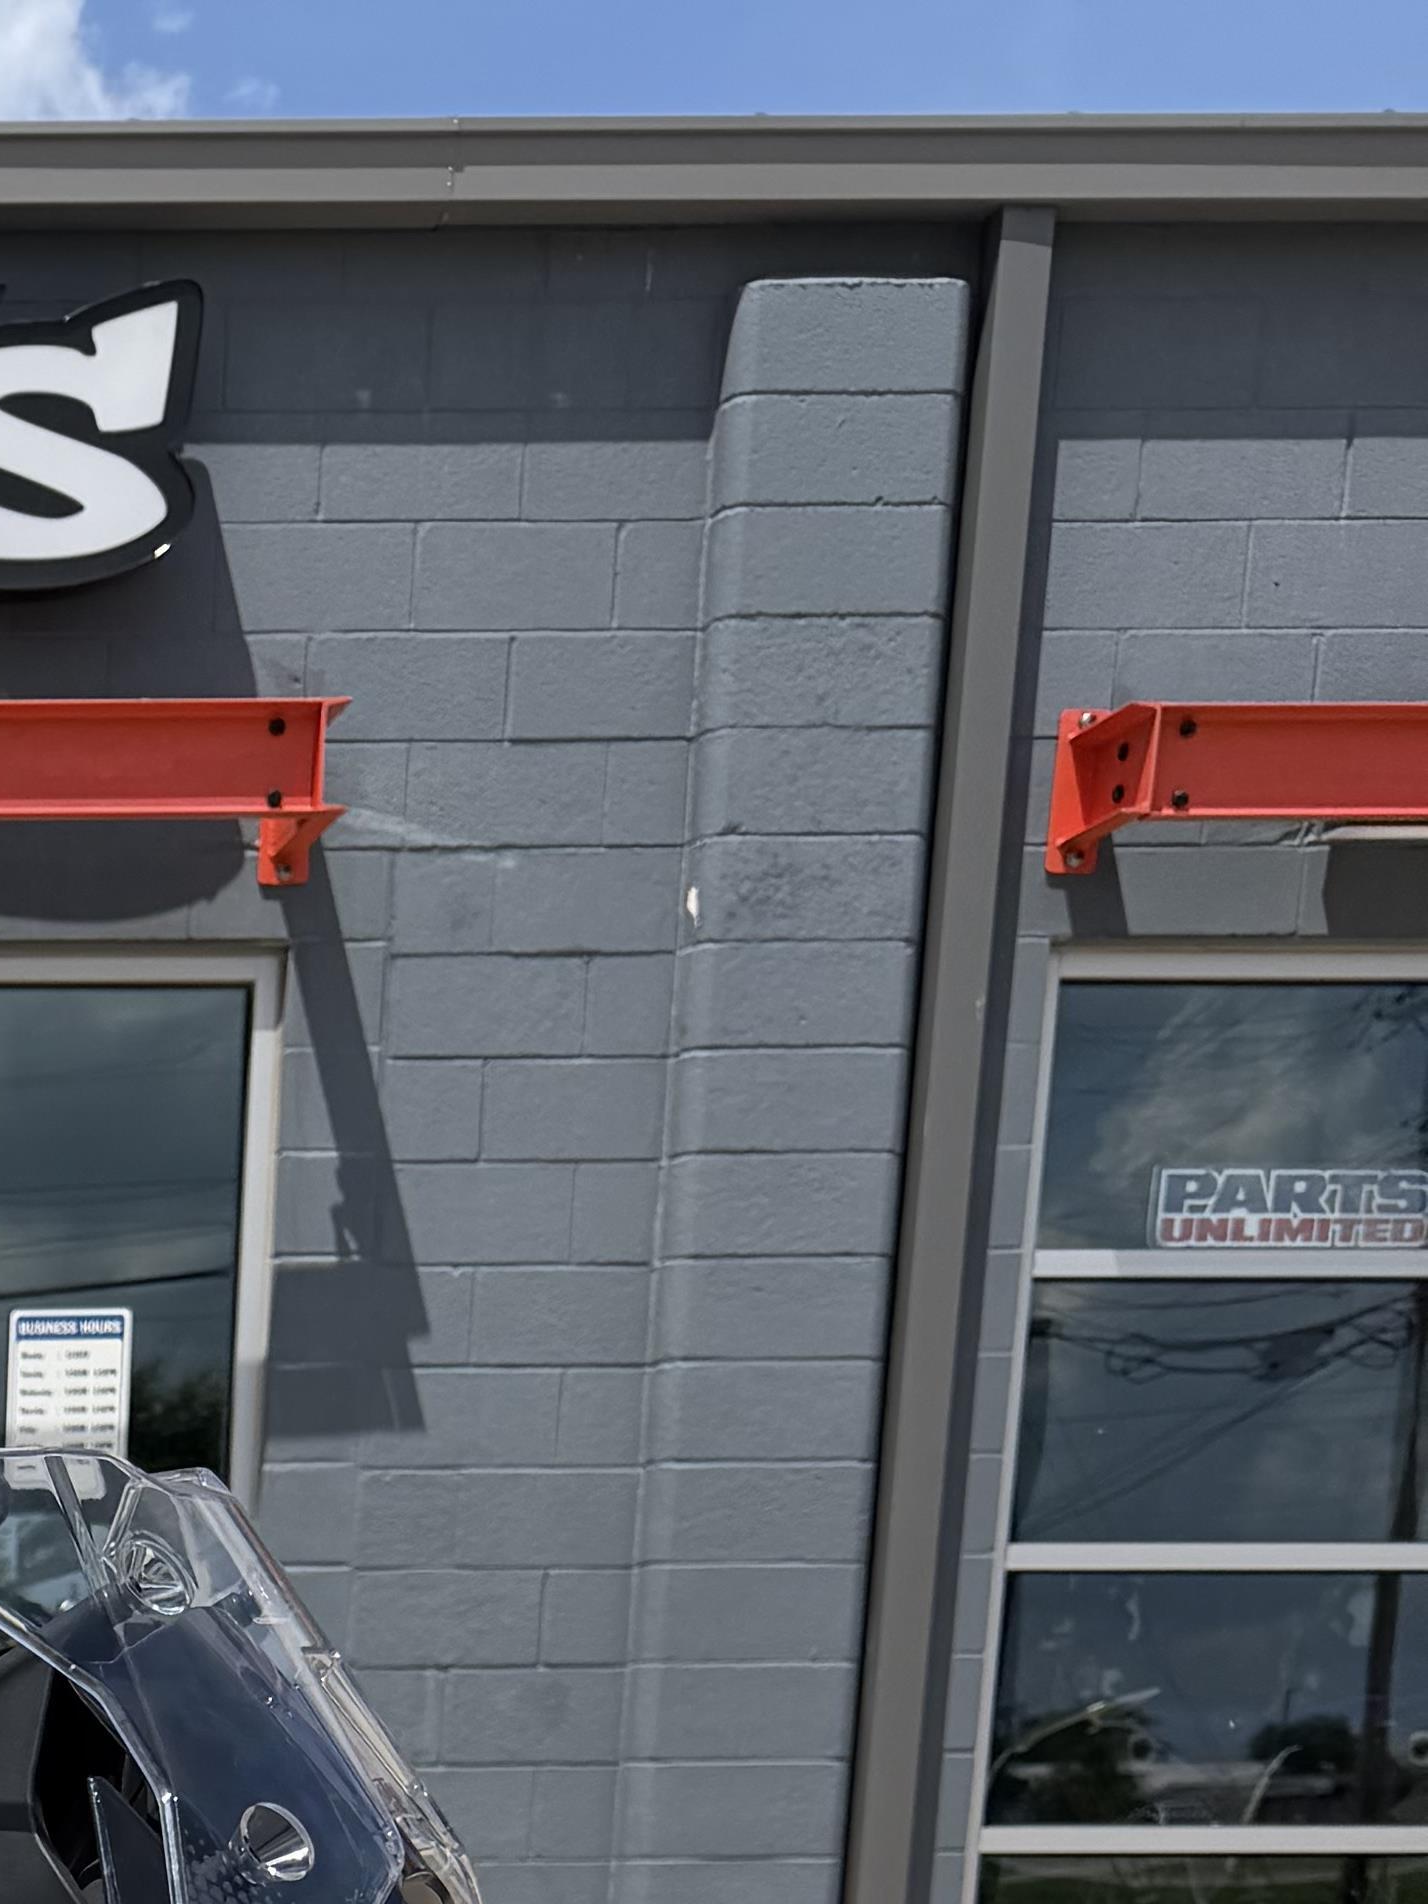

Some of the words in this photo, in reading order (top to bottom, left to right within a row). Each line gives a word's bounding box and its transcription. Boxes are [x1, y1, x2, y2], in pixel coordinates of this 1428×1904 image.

[1161, 1170, 1428, 1215] PARTS
[1159, 1217, 1428, 1243] UNLIMITED
[18, 1319, 78, 1336] BUSINESS
[79, 1318, 123, 1335] HOURS
